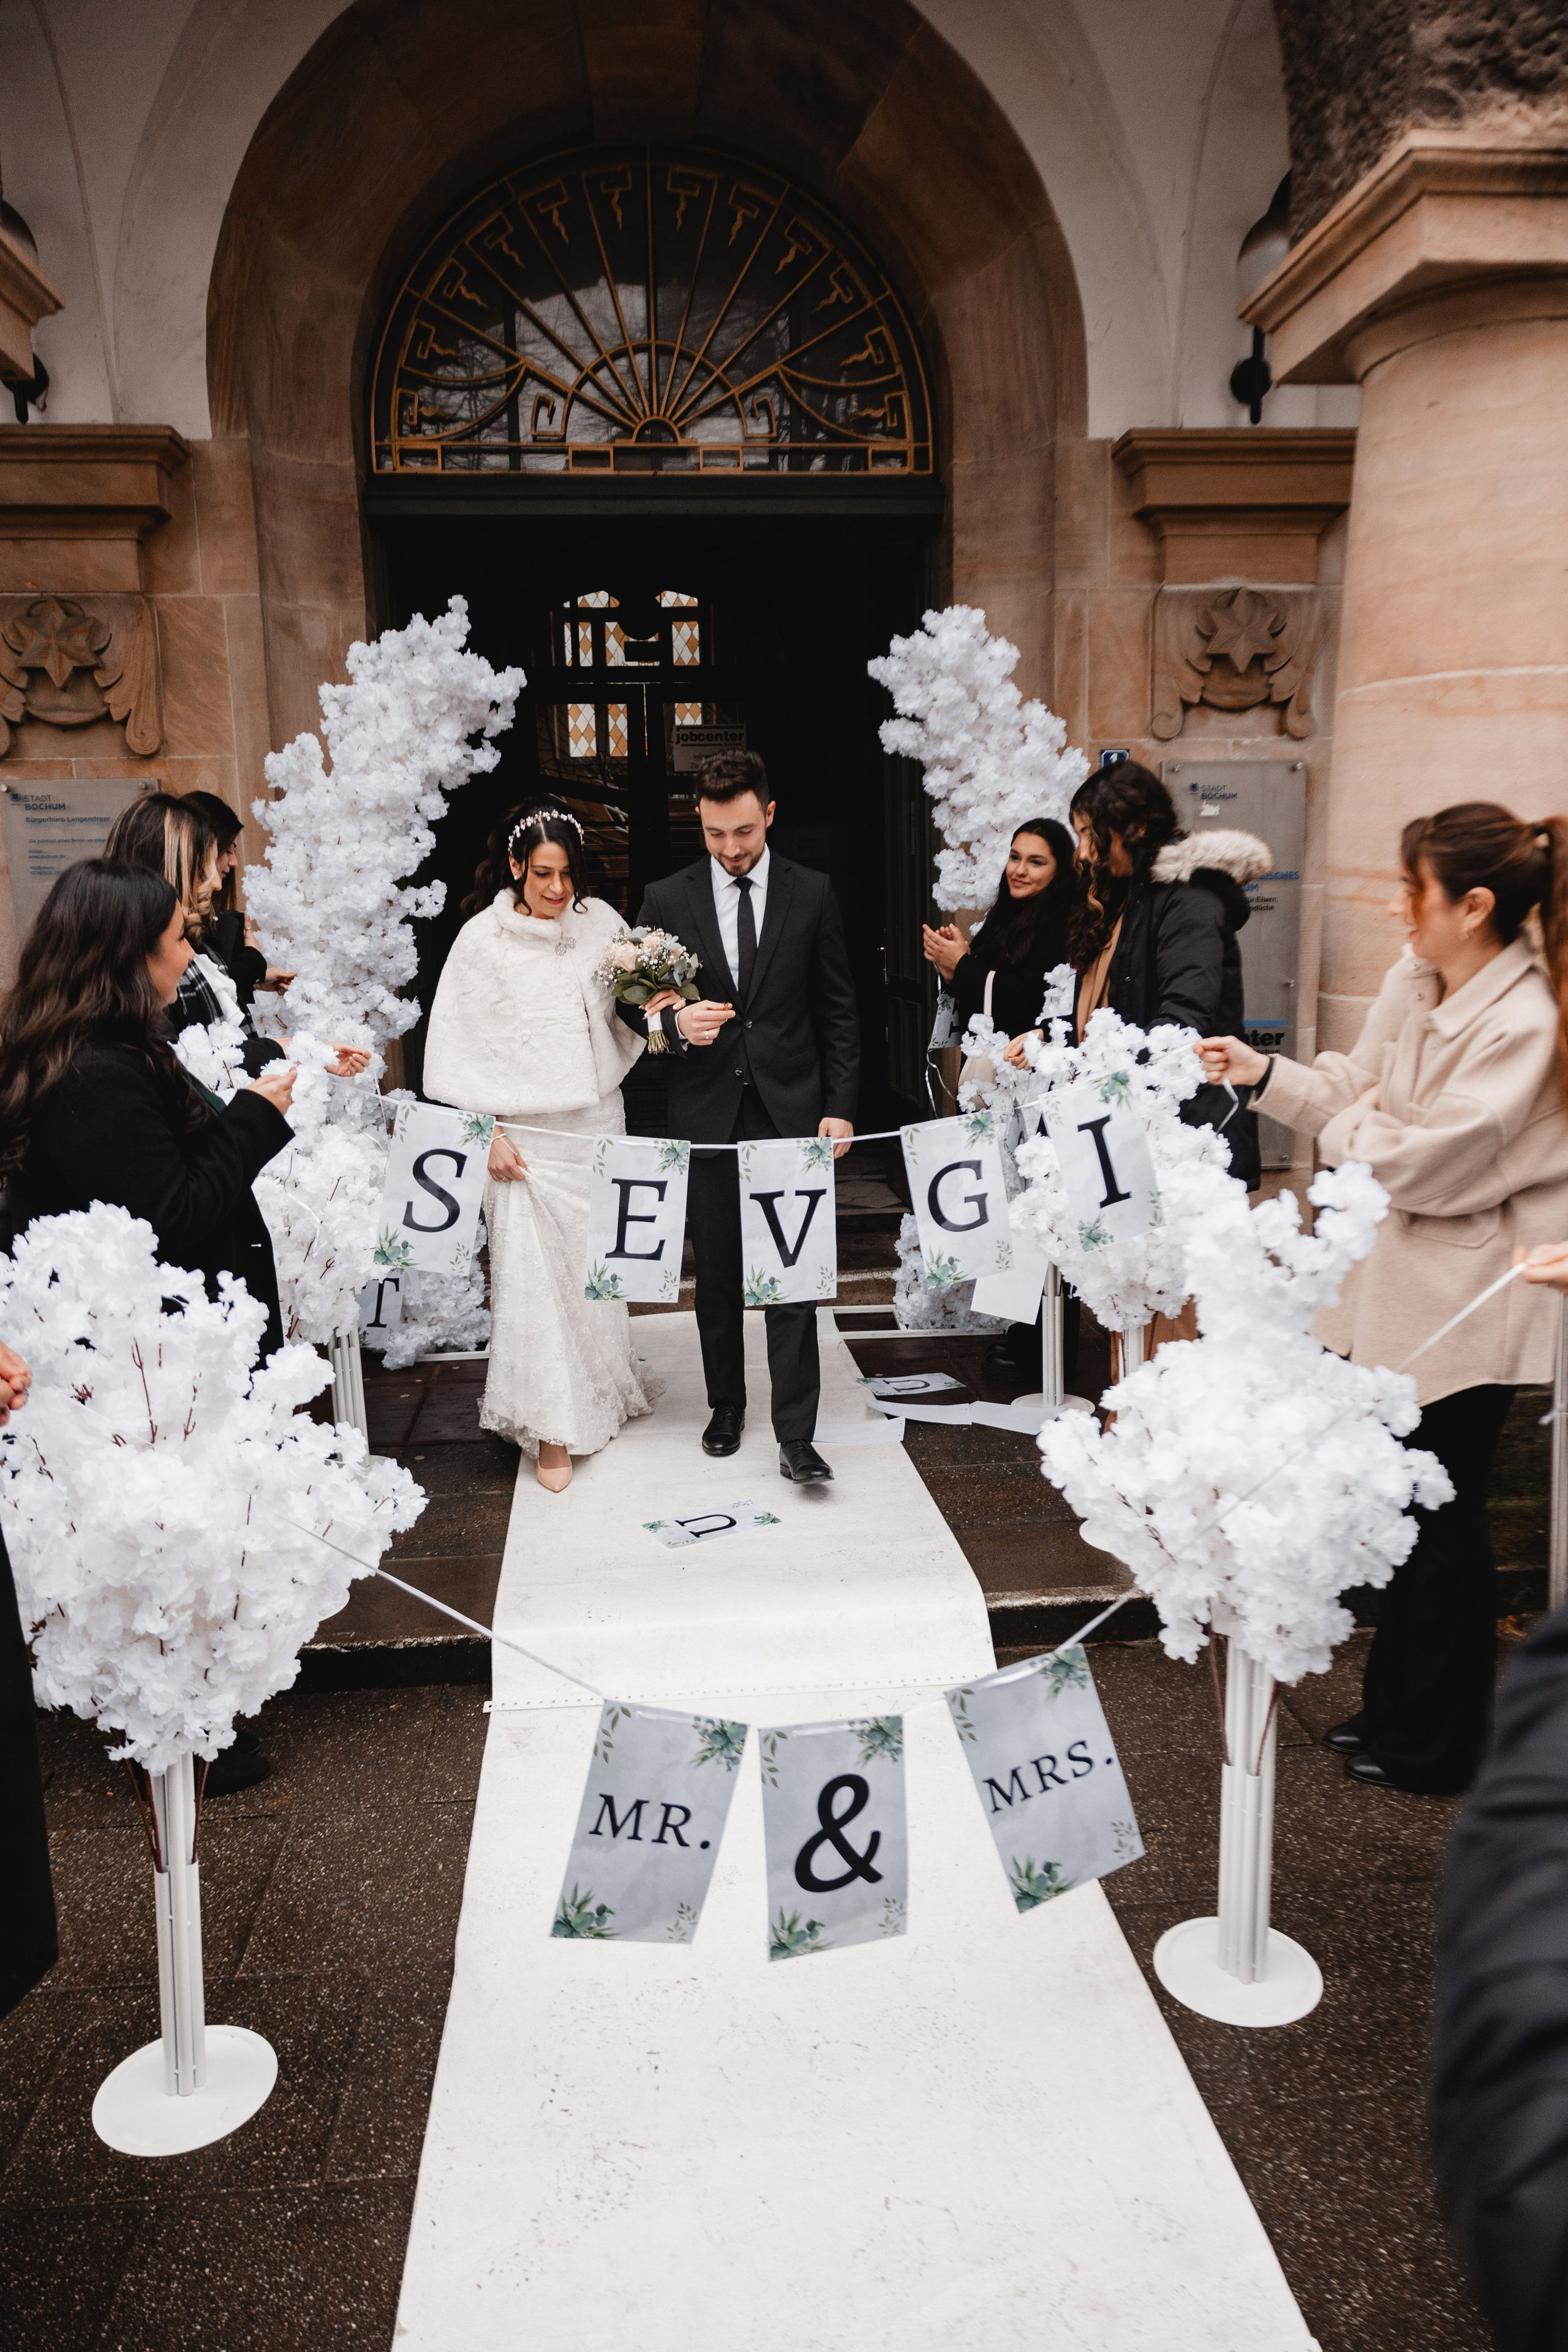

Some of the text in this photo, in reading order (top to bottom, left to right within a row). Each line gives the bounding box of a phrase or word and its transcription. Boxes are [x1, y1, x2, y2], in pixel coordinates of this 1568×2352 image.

[676, 731, 744, 744] jobcenter
[402, 1115, 1131, 1268] S E V G I
[589, 1740, 1114, 1893] MR. & MRS.
